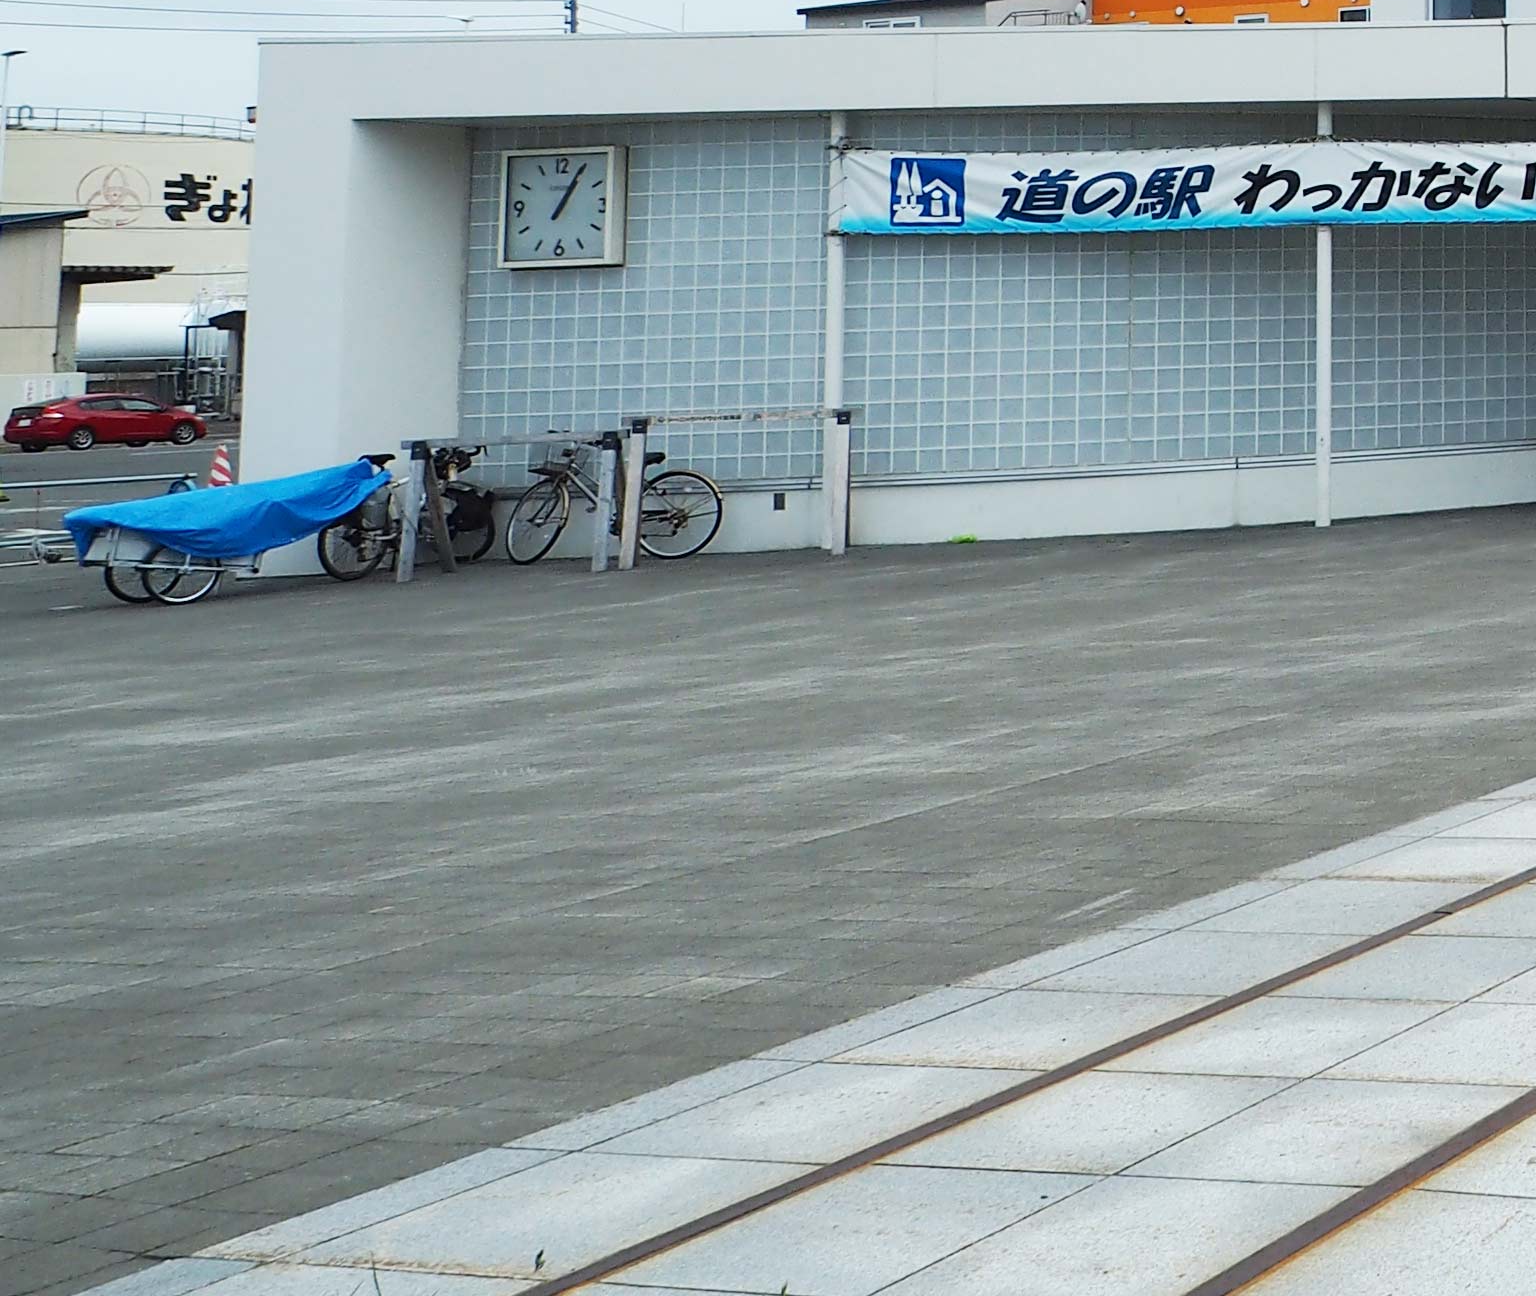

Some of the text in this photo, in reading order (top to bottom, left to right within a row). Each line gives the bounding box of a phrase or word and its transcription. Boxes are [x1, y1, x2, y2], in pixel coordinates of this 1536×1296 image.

[555, 157, 569, 175] 12
[995, 164, 1215, 224] 道の駅
[513, 200, 525, 218] 9
[597, 197, 606, 214] 3
[553, 238, 565, 257] 6
